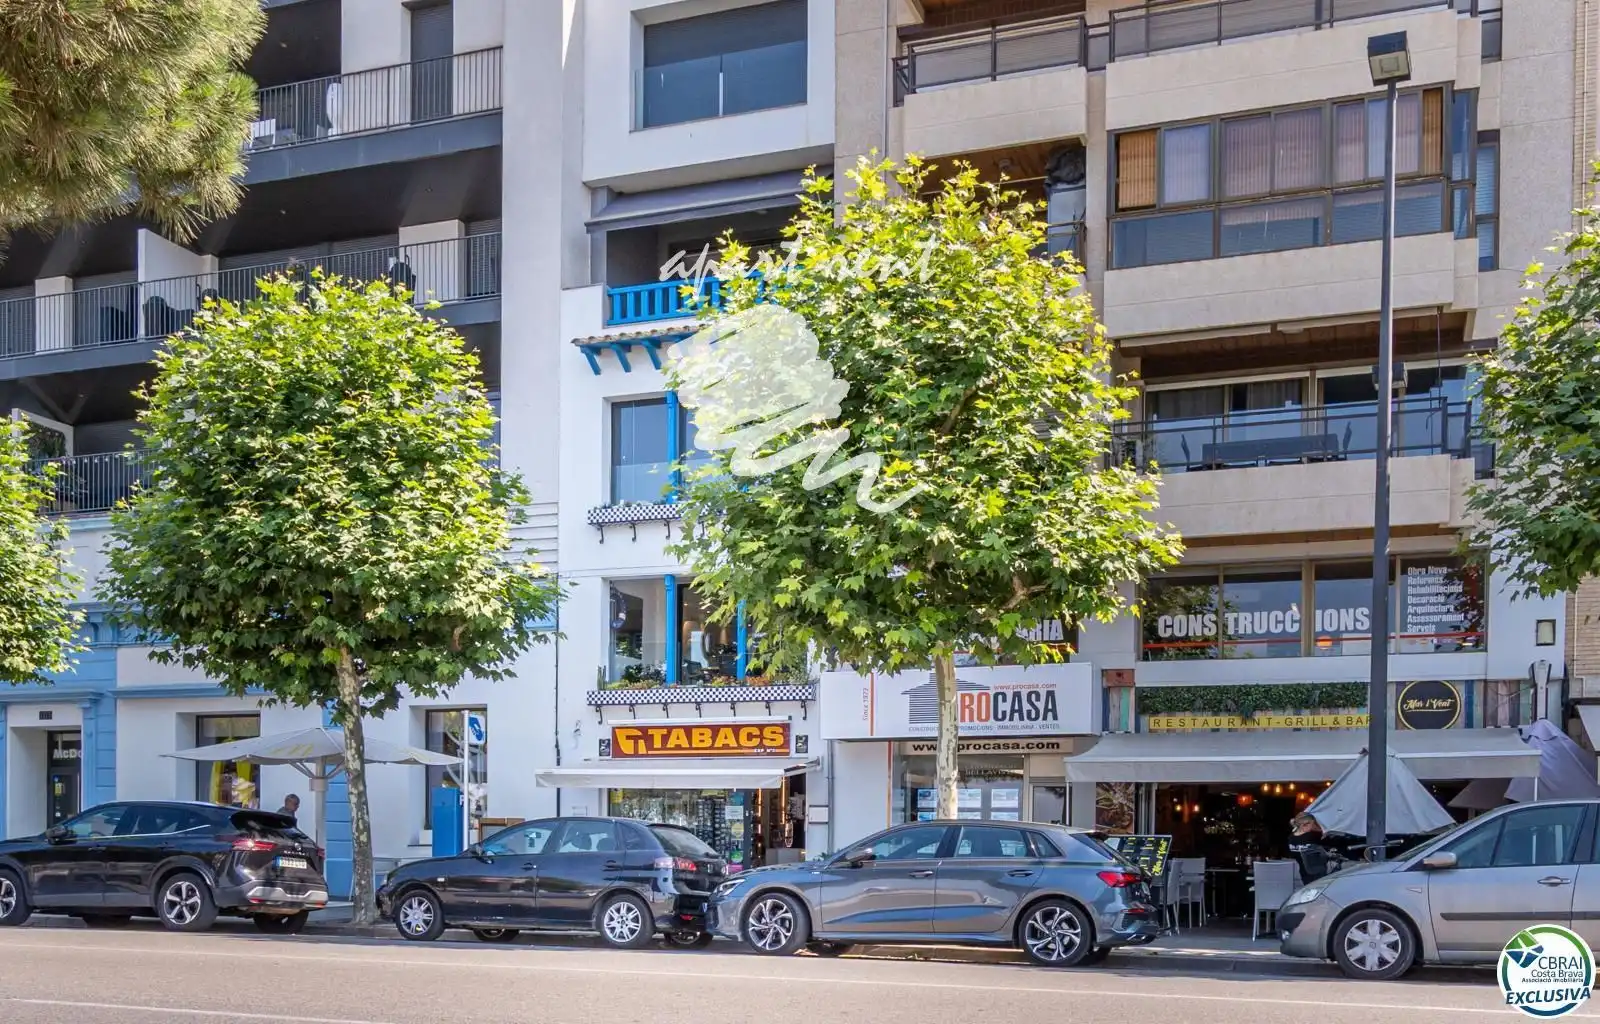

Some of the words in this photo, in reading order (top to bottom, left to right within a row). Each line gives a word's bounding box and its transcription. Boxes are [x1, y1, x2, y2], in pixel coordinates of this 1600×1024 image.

[1407, 567, 1426, 575] Obra
[1427, 566, 1448, 575] Nova
[959, 690, 1059, 723] ROCASA
[648, 726, 784, 748] TABACS
[912, 741, 1060, 753] wwprocasa.com
